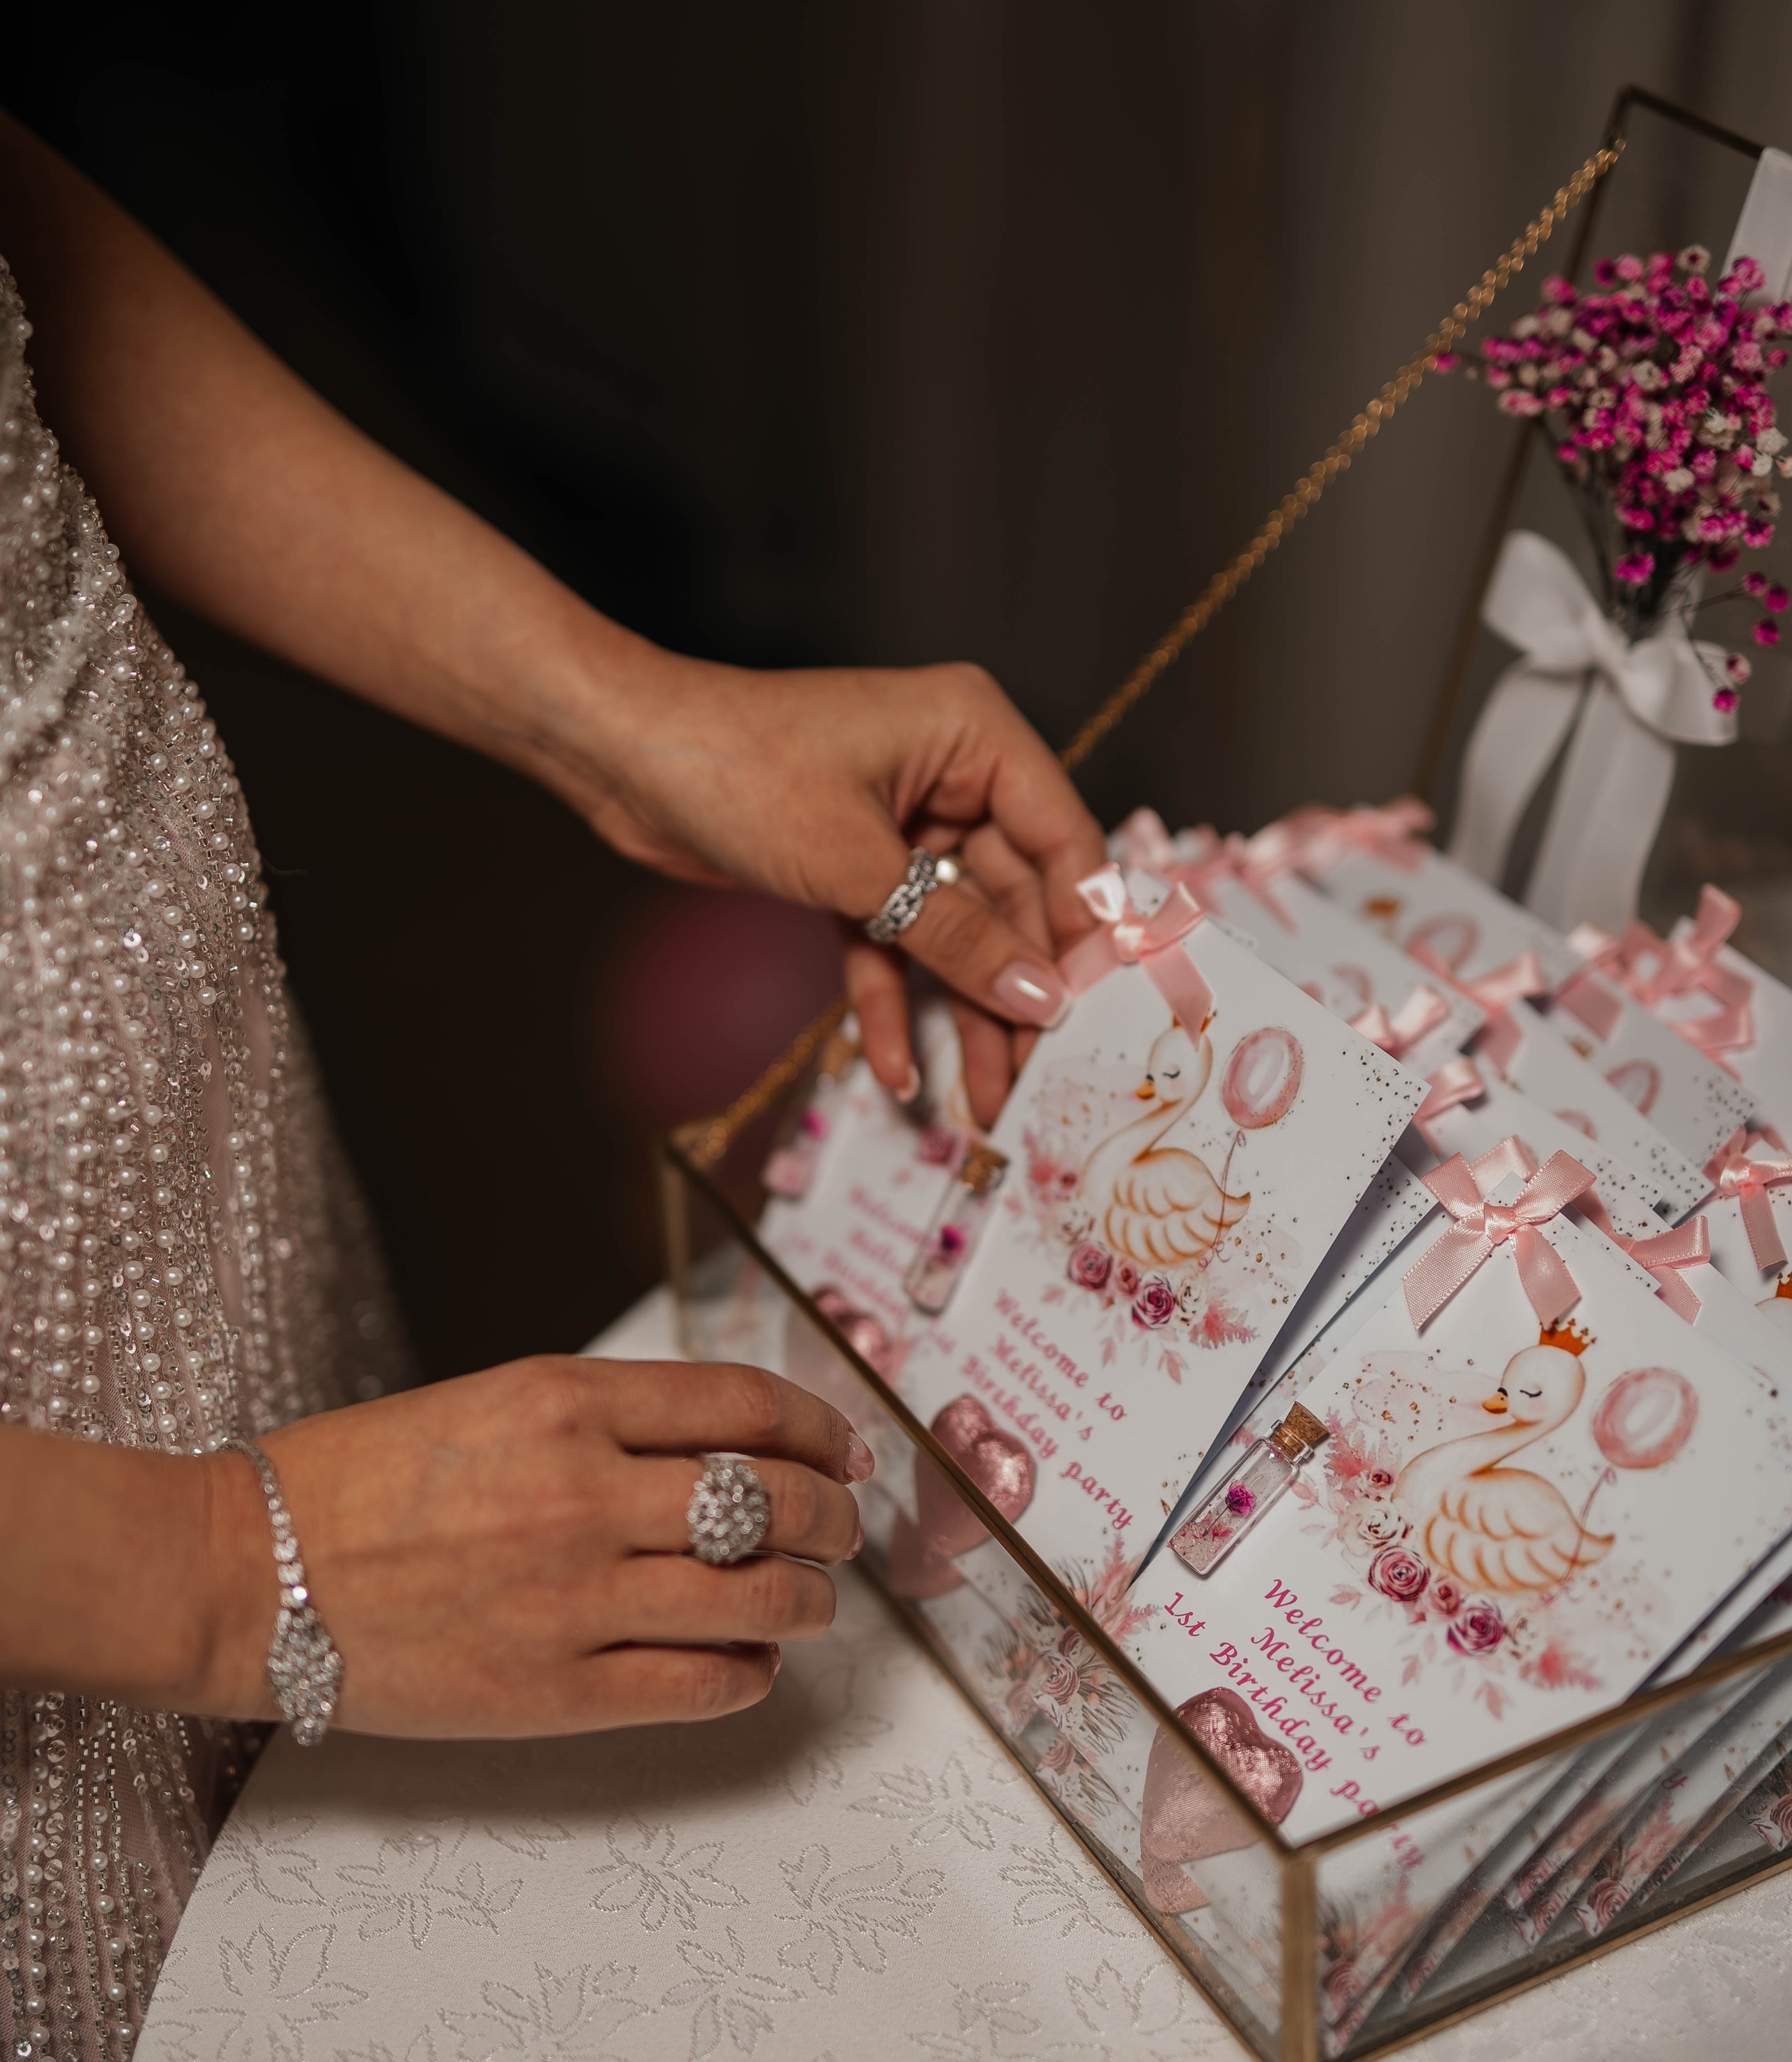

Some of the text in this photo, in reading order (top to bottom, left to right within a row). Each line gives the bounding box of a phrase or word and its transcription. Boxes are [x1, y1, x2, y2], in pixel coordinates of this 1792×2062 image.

[995, 1289, 1089, 1389] Welcome
[1096, 1392, 1126, 1421] to
[1058, 1461, 1133, 1531] party
[1163, 1591, 1208, 1638] 1st
[1208, 1640, 1333, 1772] Birthday
[1250, 1626, 1381, 1761] Melissa's
[1264, 1577, 1427, 1747] Welcome to
